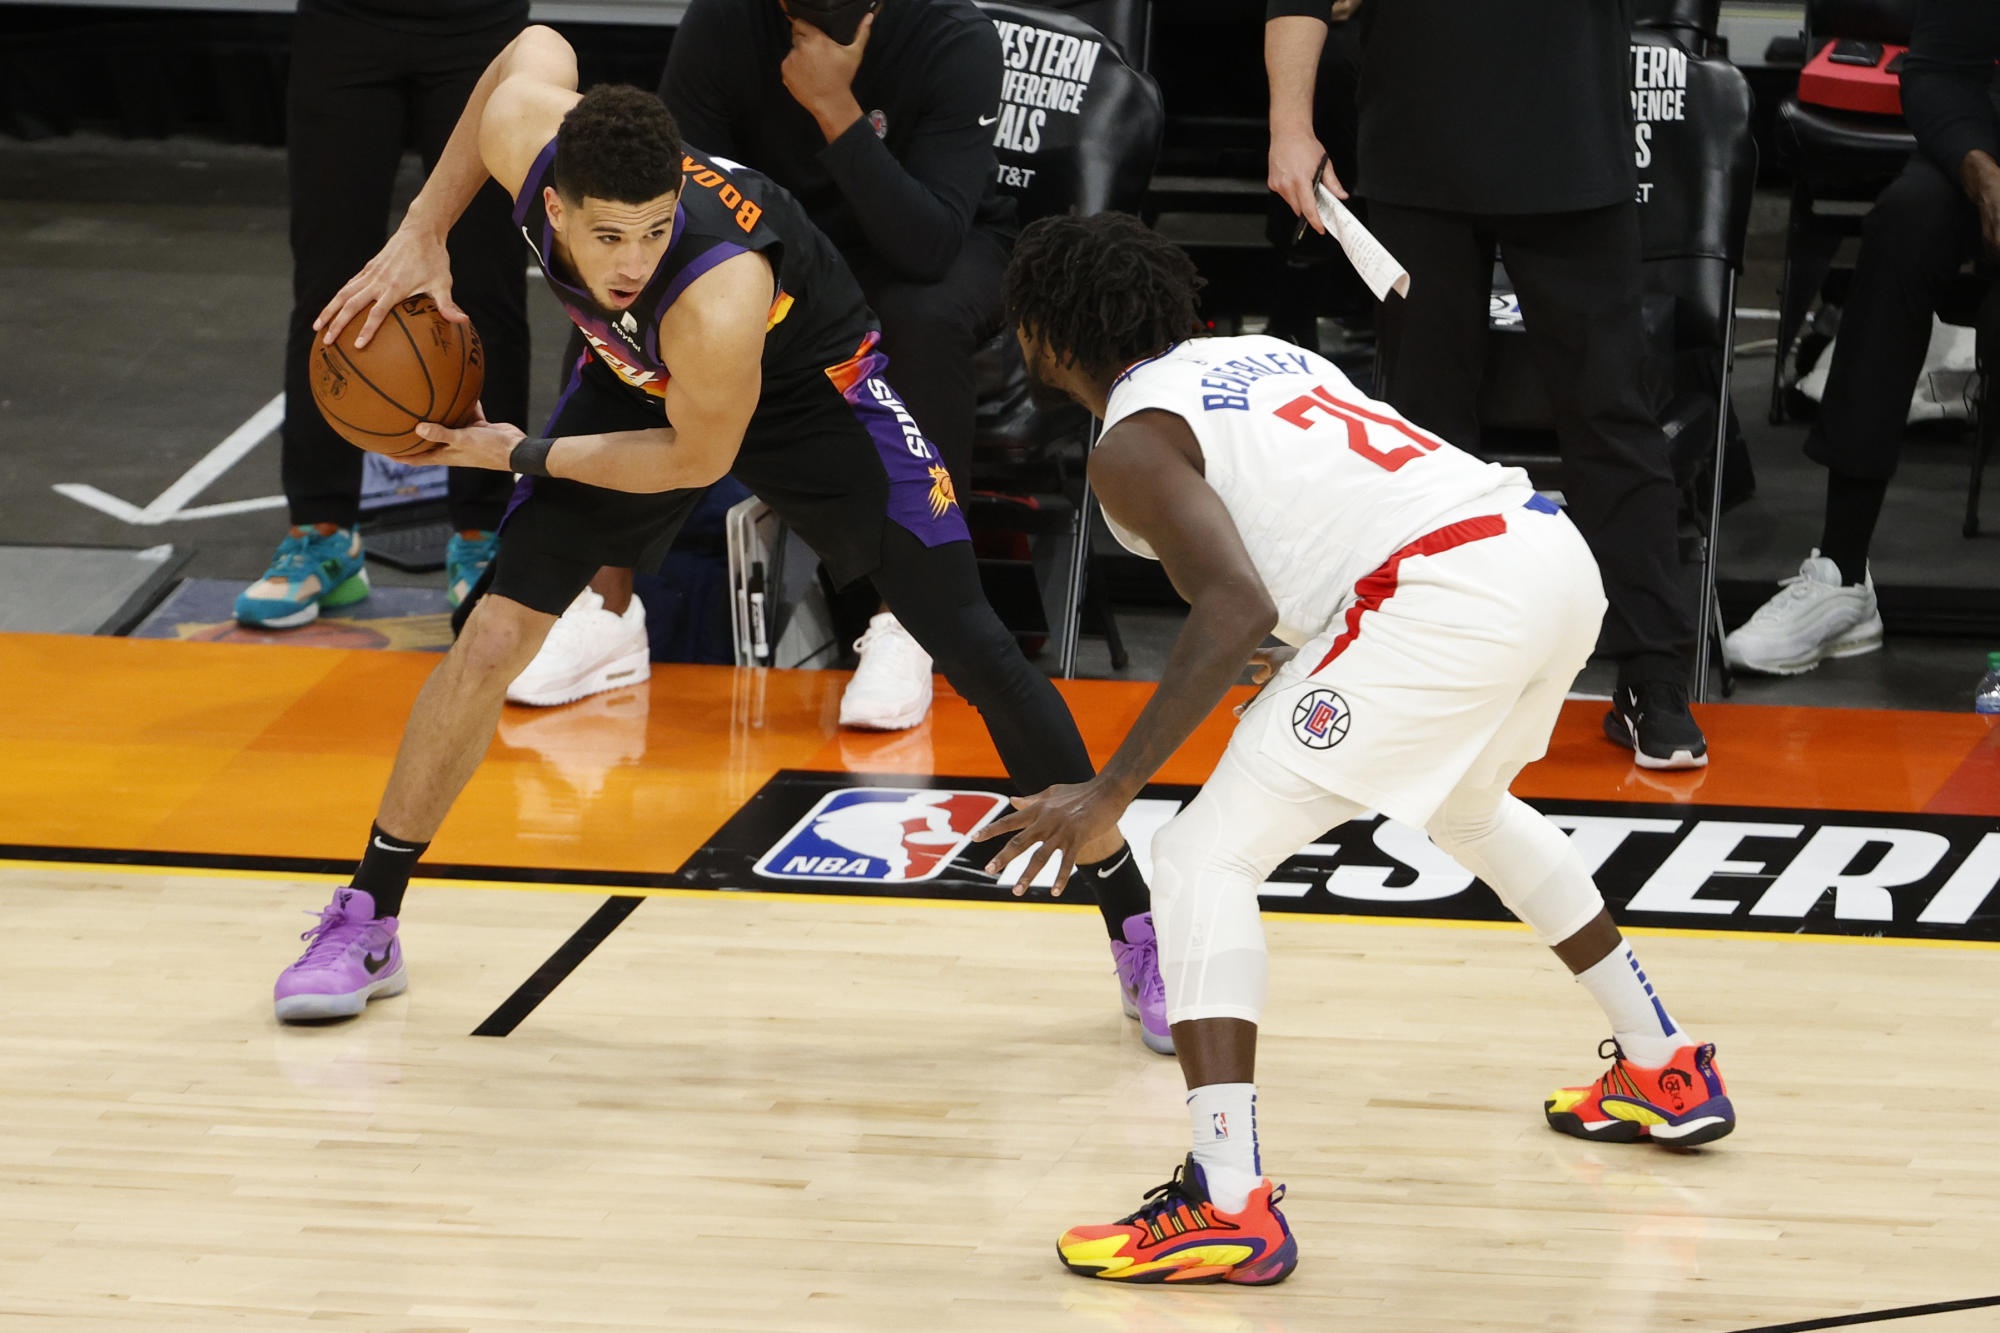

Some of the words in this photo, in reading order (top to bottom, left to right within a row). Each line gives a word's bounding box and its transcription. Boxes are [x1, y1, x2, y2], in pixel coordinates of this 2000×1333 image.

[993, 102, 1047, 154] ALS
[681, 151, 763, 233] BOOK
[996, 163, 1036, 189] T&T
[611, 321, 641, 352] PayPal
[1201, 352, 1314, 411] BEVERLEY
[867, 378, 932, 459] SUNS
[1272, 384, 1443, 473] 21
[781, 855, 871, 877] NBA
